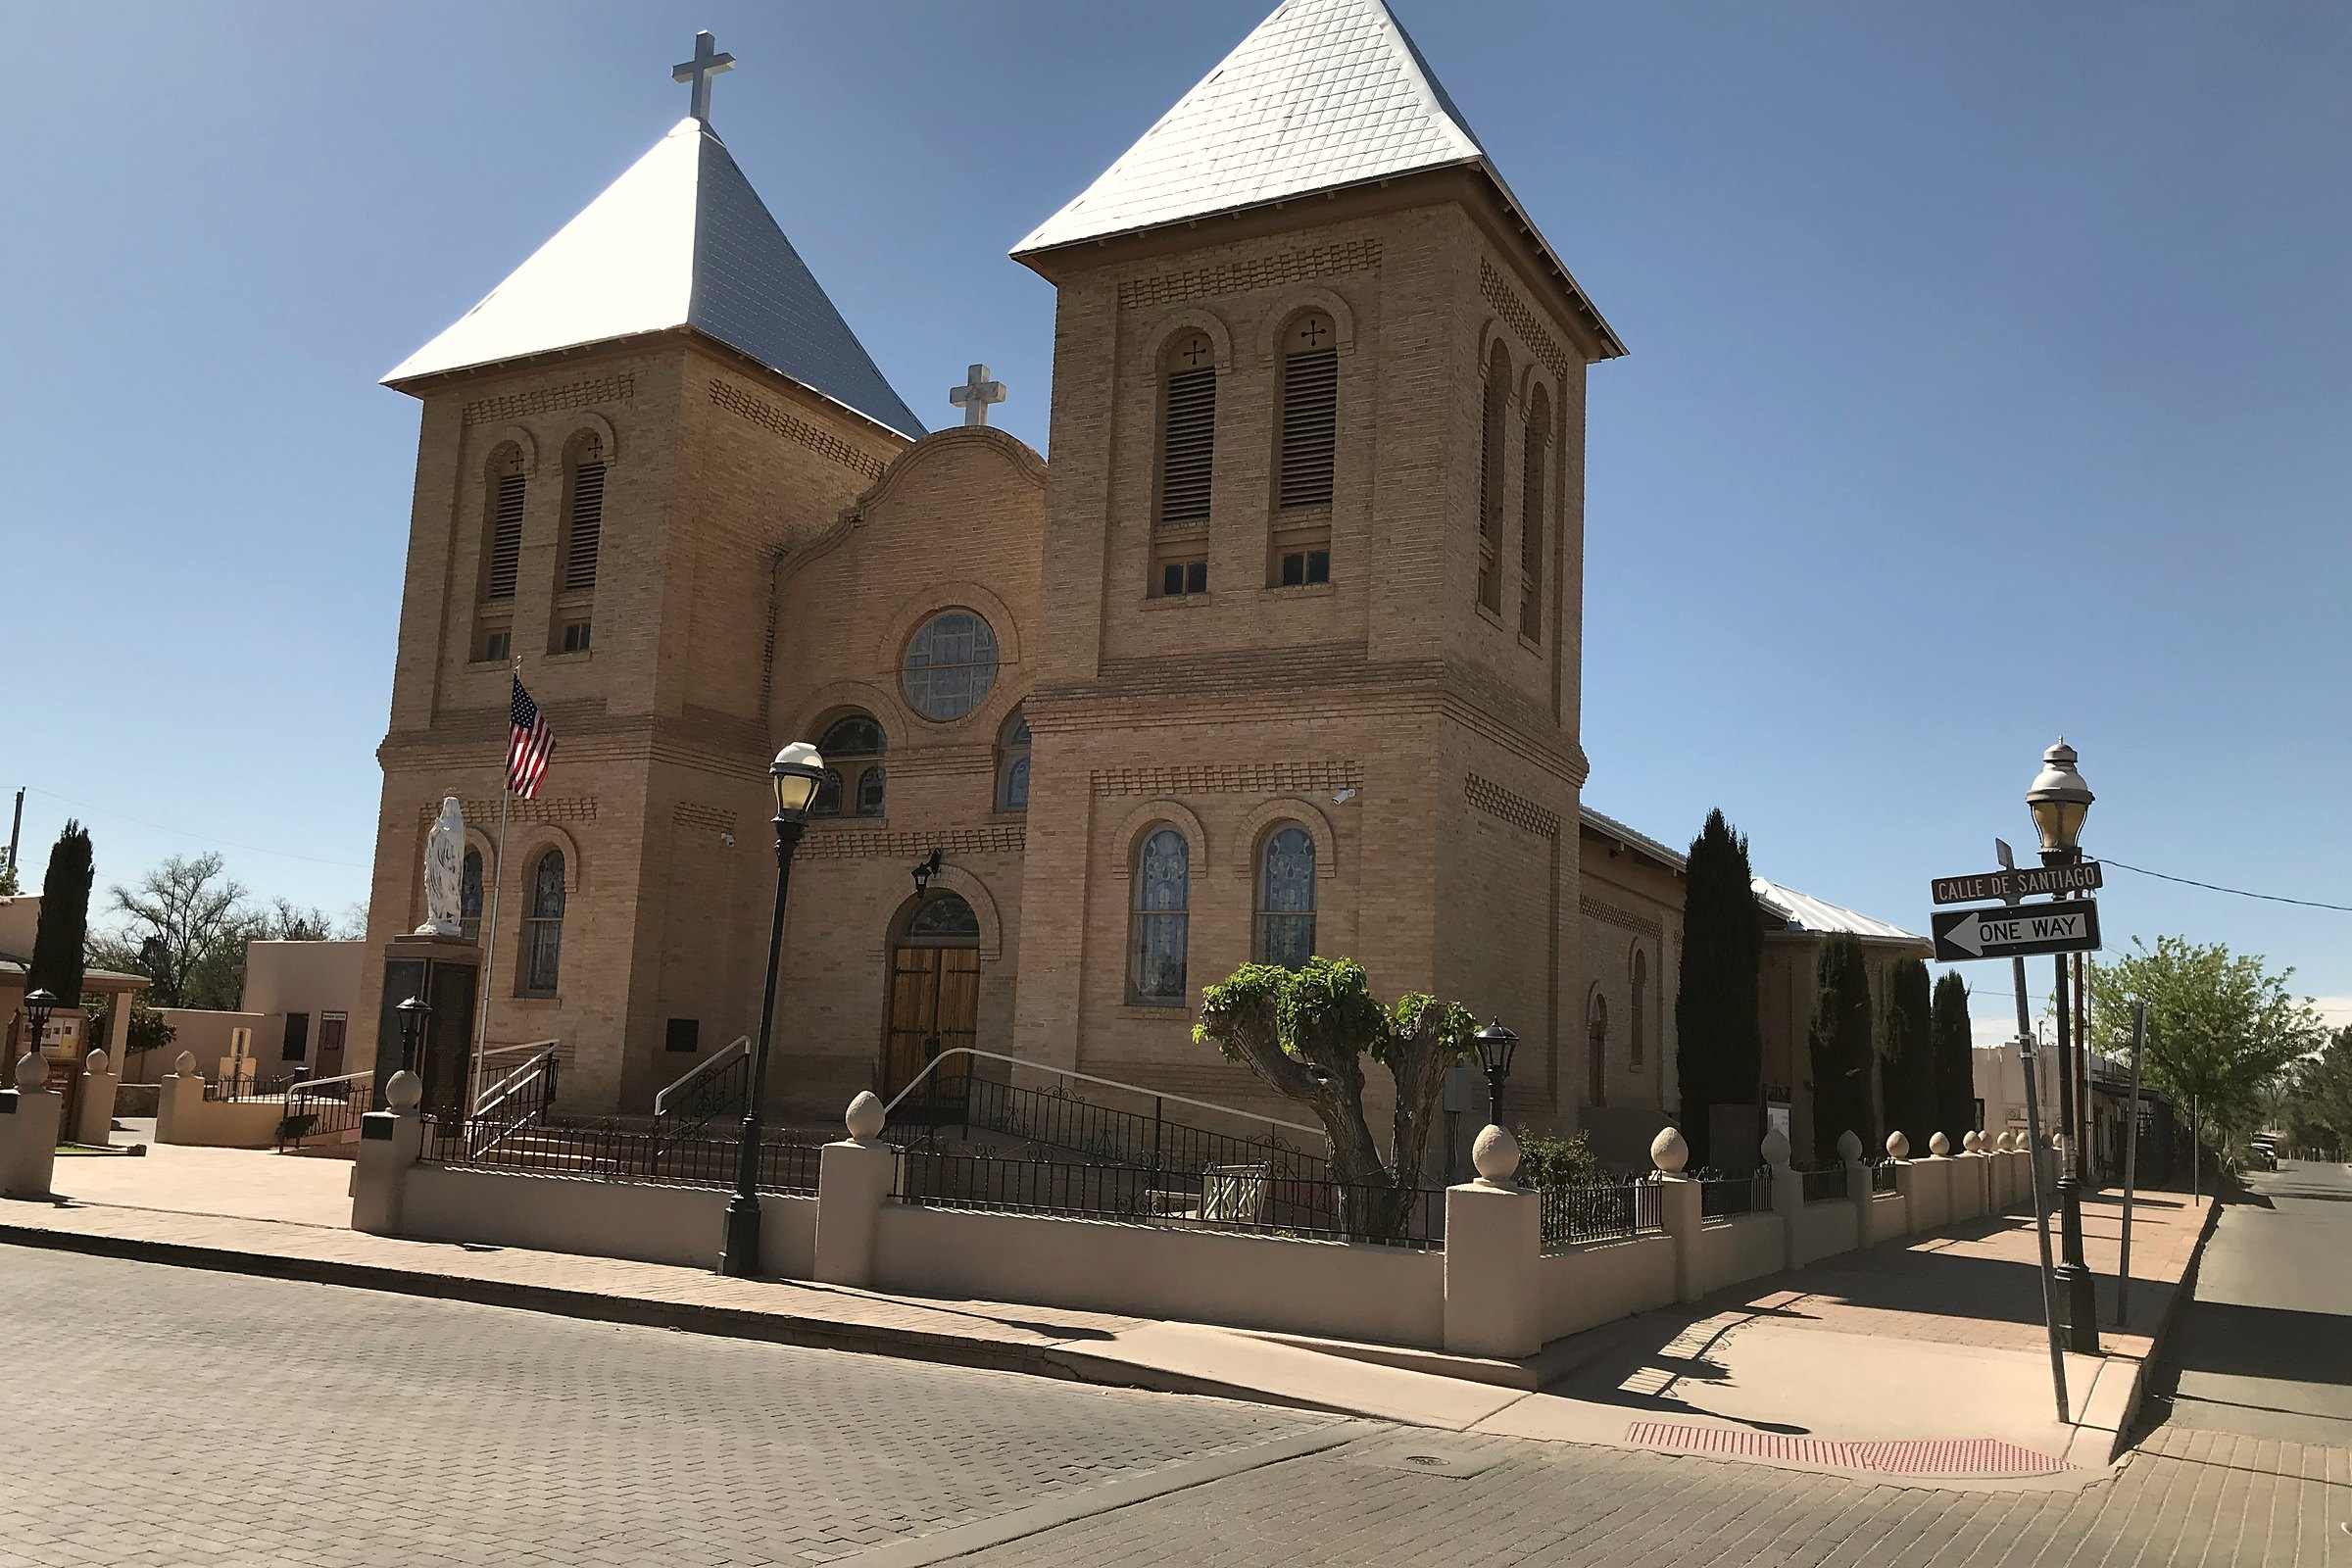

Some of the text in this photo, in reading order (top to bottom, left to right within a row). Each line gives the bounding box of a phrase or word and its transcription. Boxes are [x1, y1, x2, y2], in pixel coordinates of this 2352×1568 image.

[1937, 866, 2096, 901] CALLE DE SANTIAGO
[1980, 916, 2077, 943] ONE WAY
